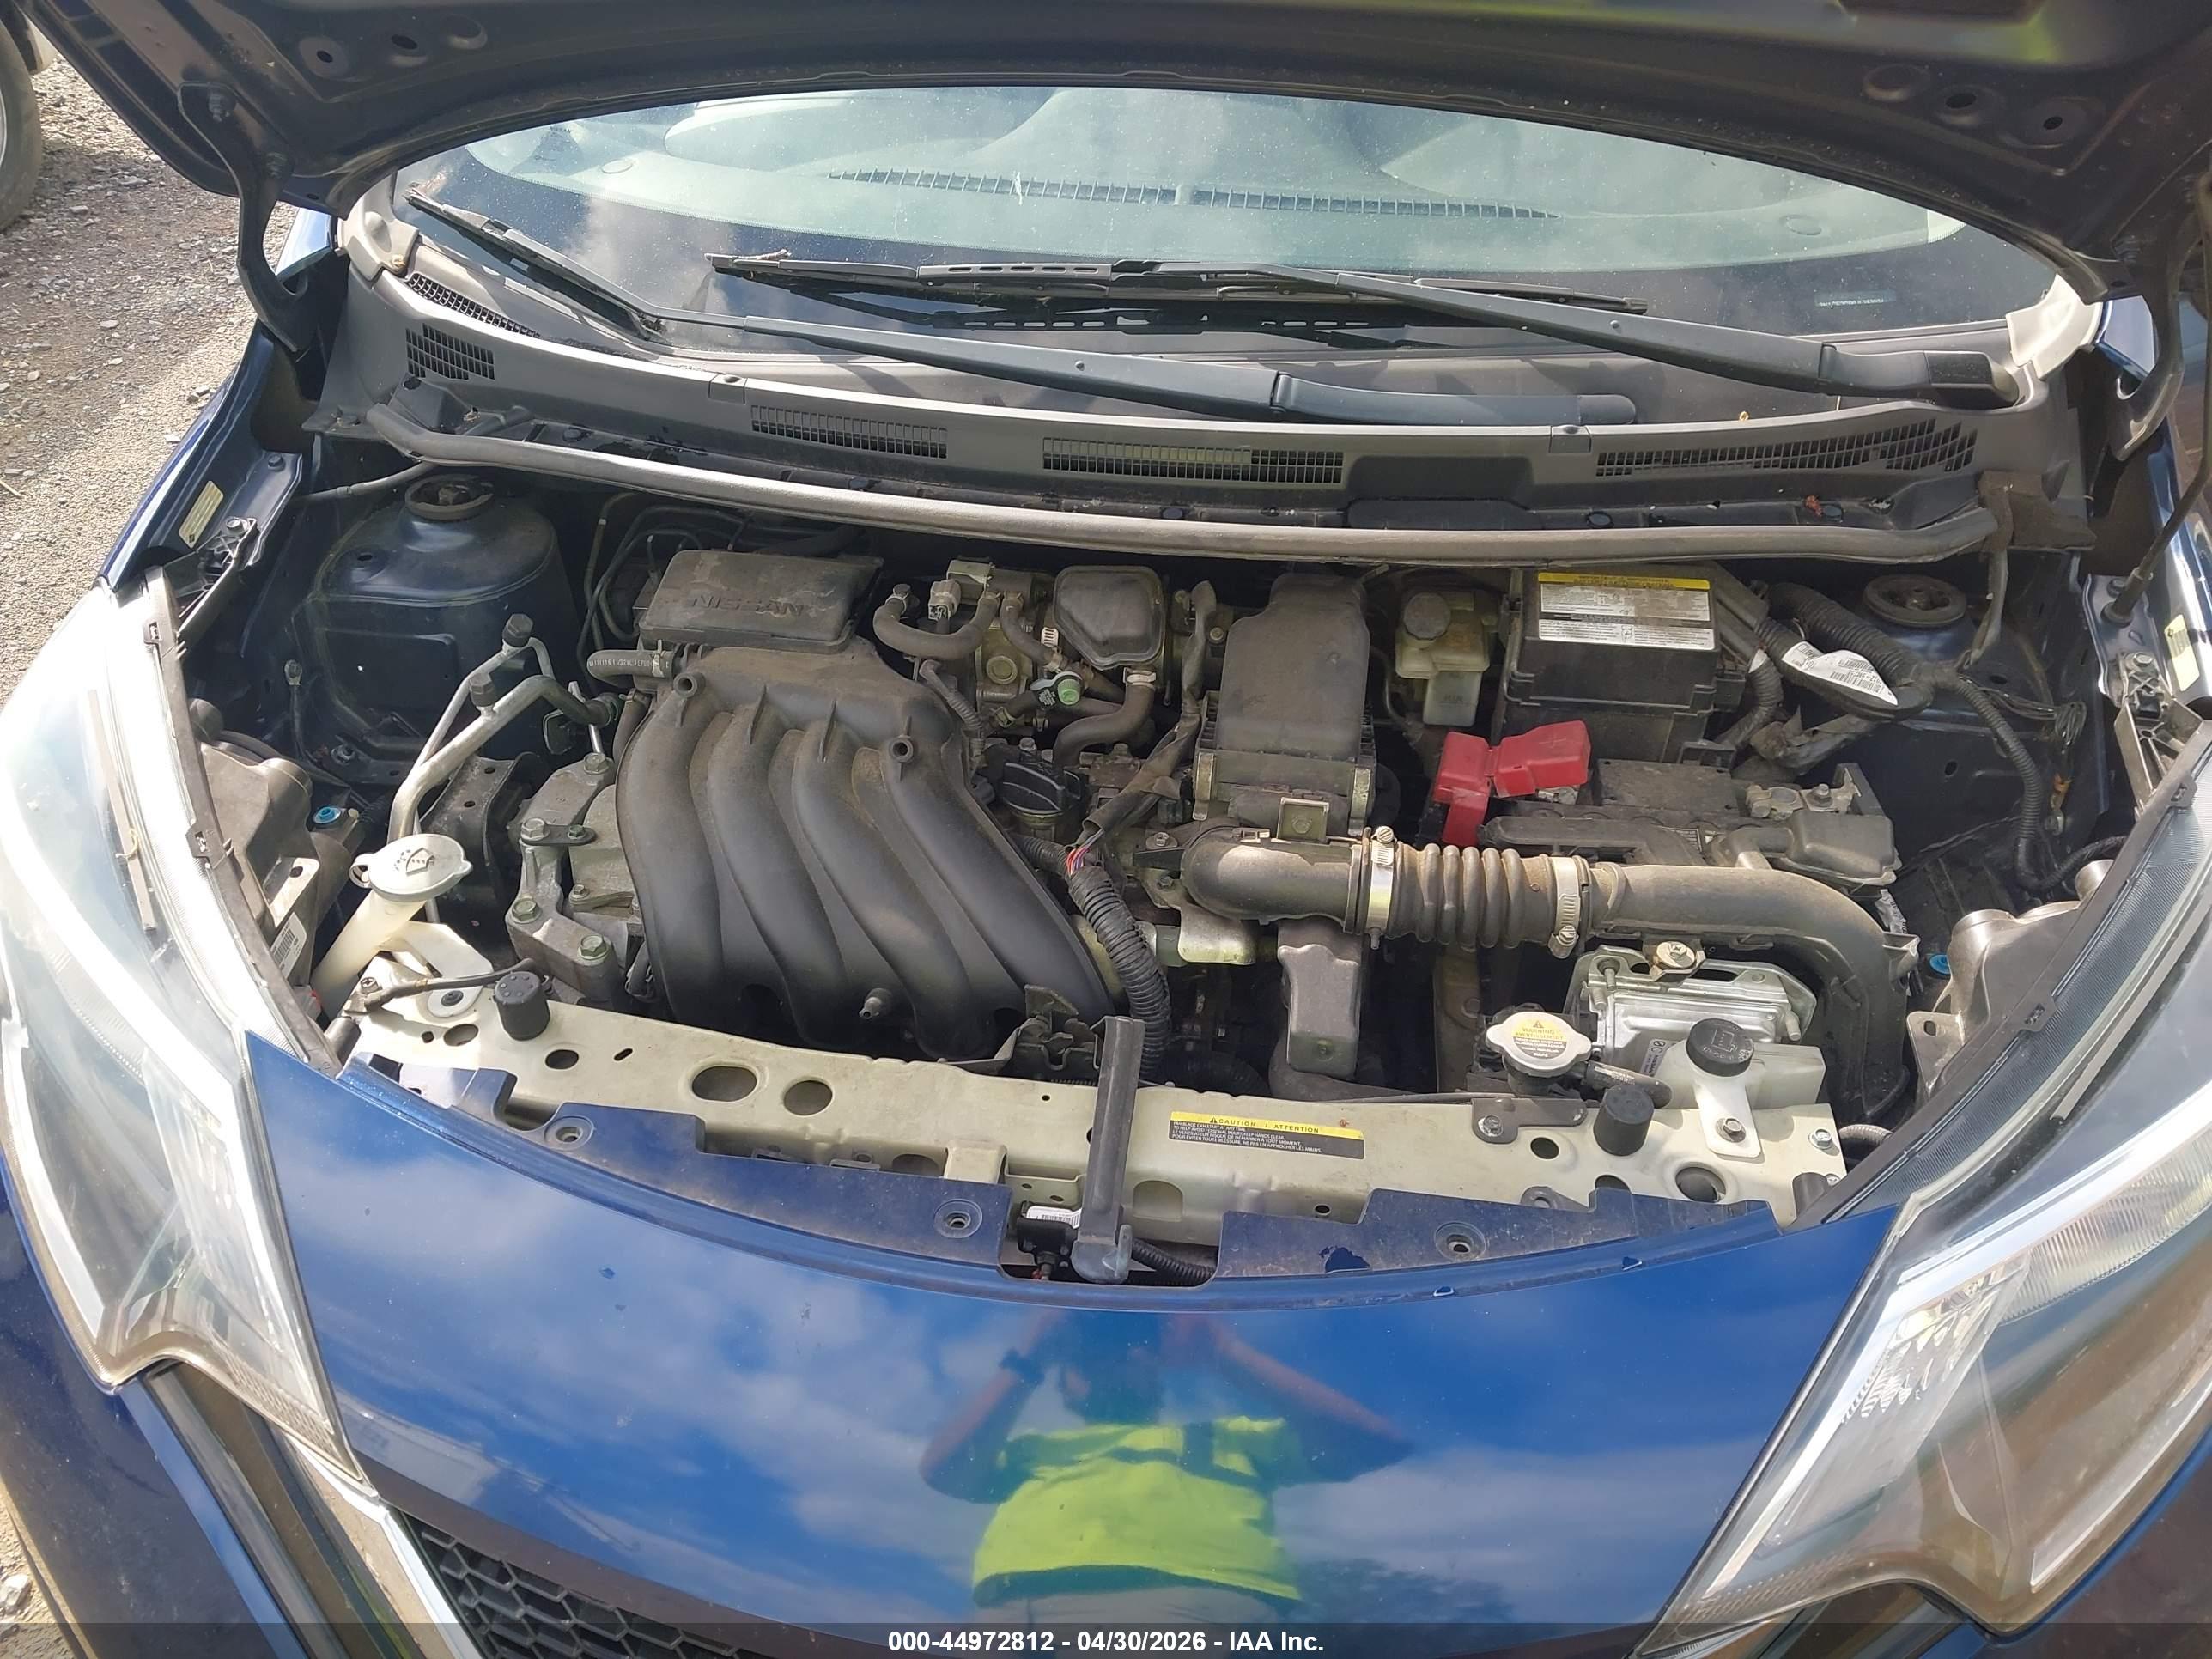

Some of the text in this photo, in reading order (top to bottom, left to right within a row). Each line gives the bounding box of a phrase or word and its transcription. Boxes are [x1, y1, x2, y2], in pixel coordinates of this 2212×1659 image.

[692, 595, 804, 617] NISSAN
[1218, 1118, 1256, 1127] CAUTION
[1273, 1124, 1319, 1133] ATTENTION
